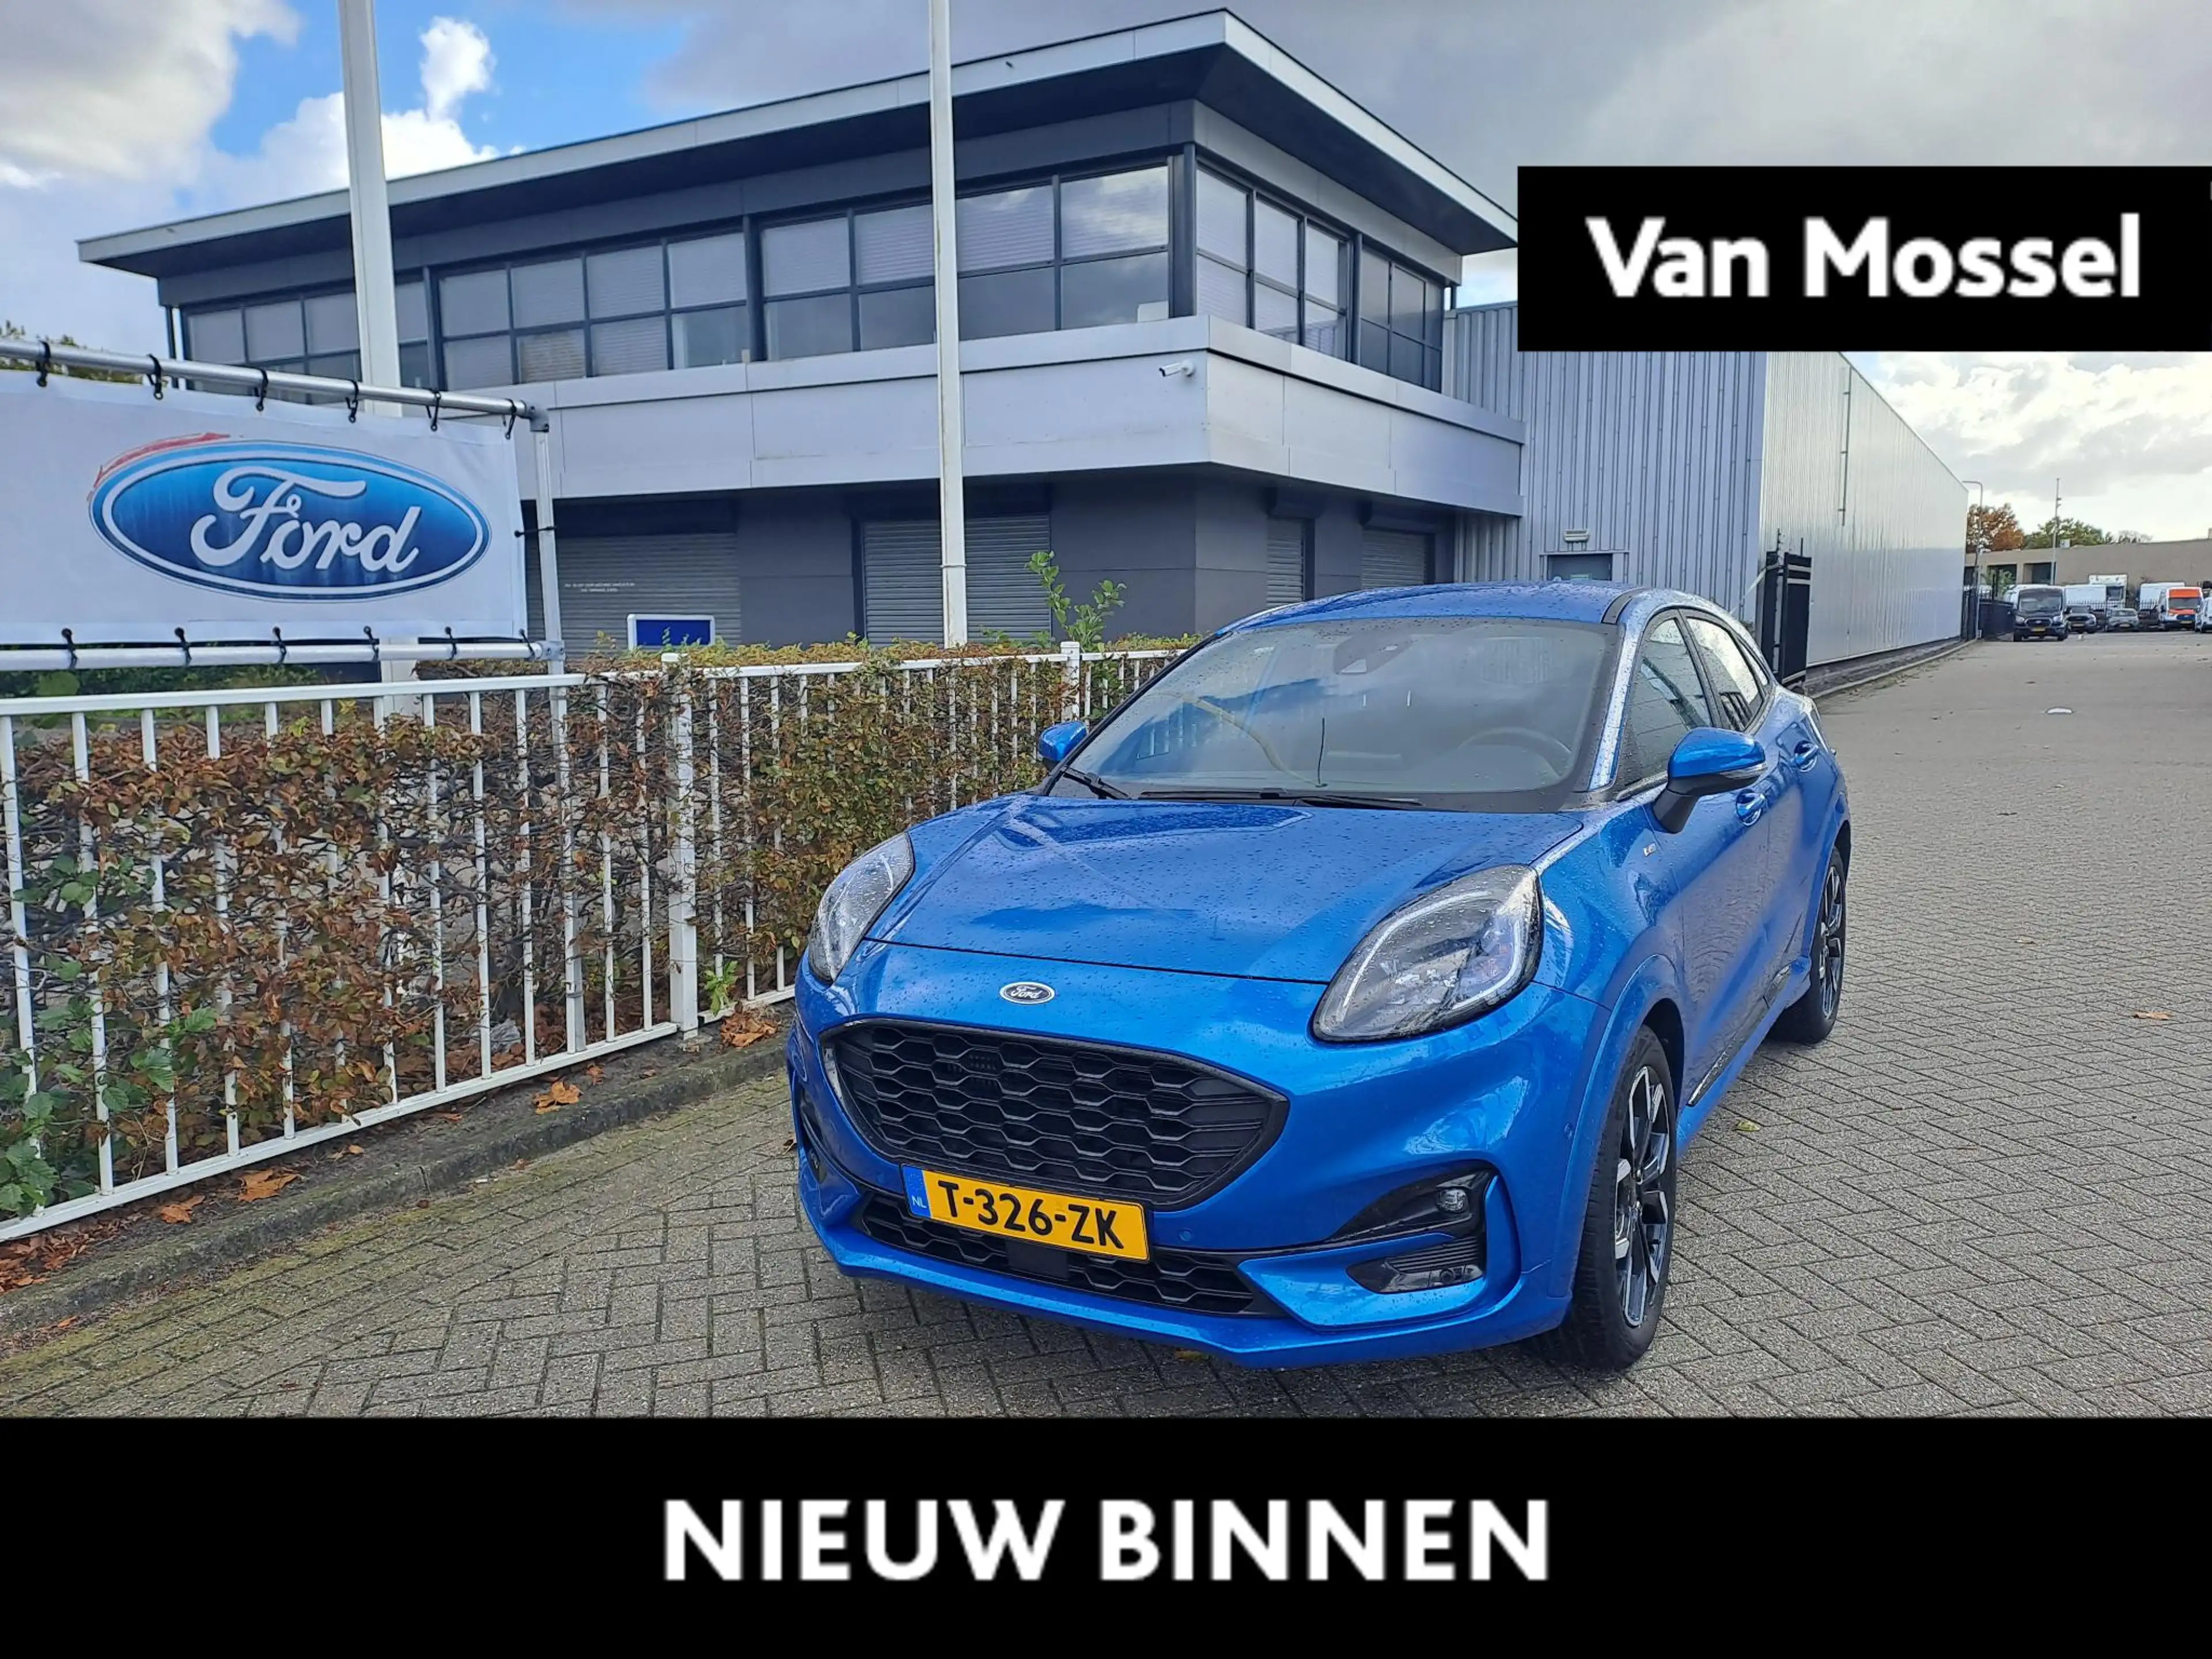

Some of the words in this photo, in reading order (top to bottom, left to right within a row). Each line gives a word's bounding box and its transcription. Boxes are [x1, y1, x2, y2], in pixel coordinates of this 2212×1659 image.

[190, 466, 421, 573] Ford
[1010, 986, 1043, 999] Ford
[911, 1195, 927, 1209] NL
[938, 1180, 1124, 1249] T-326-ZK
